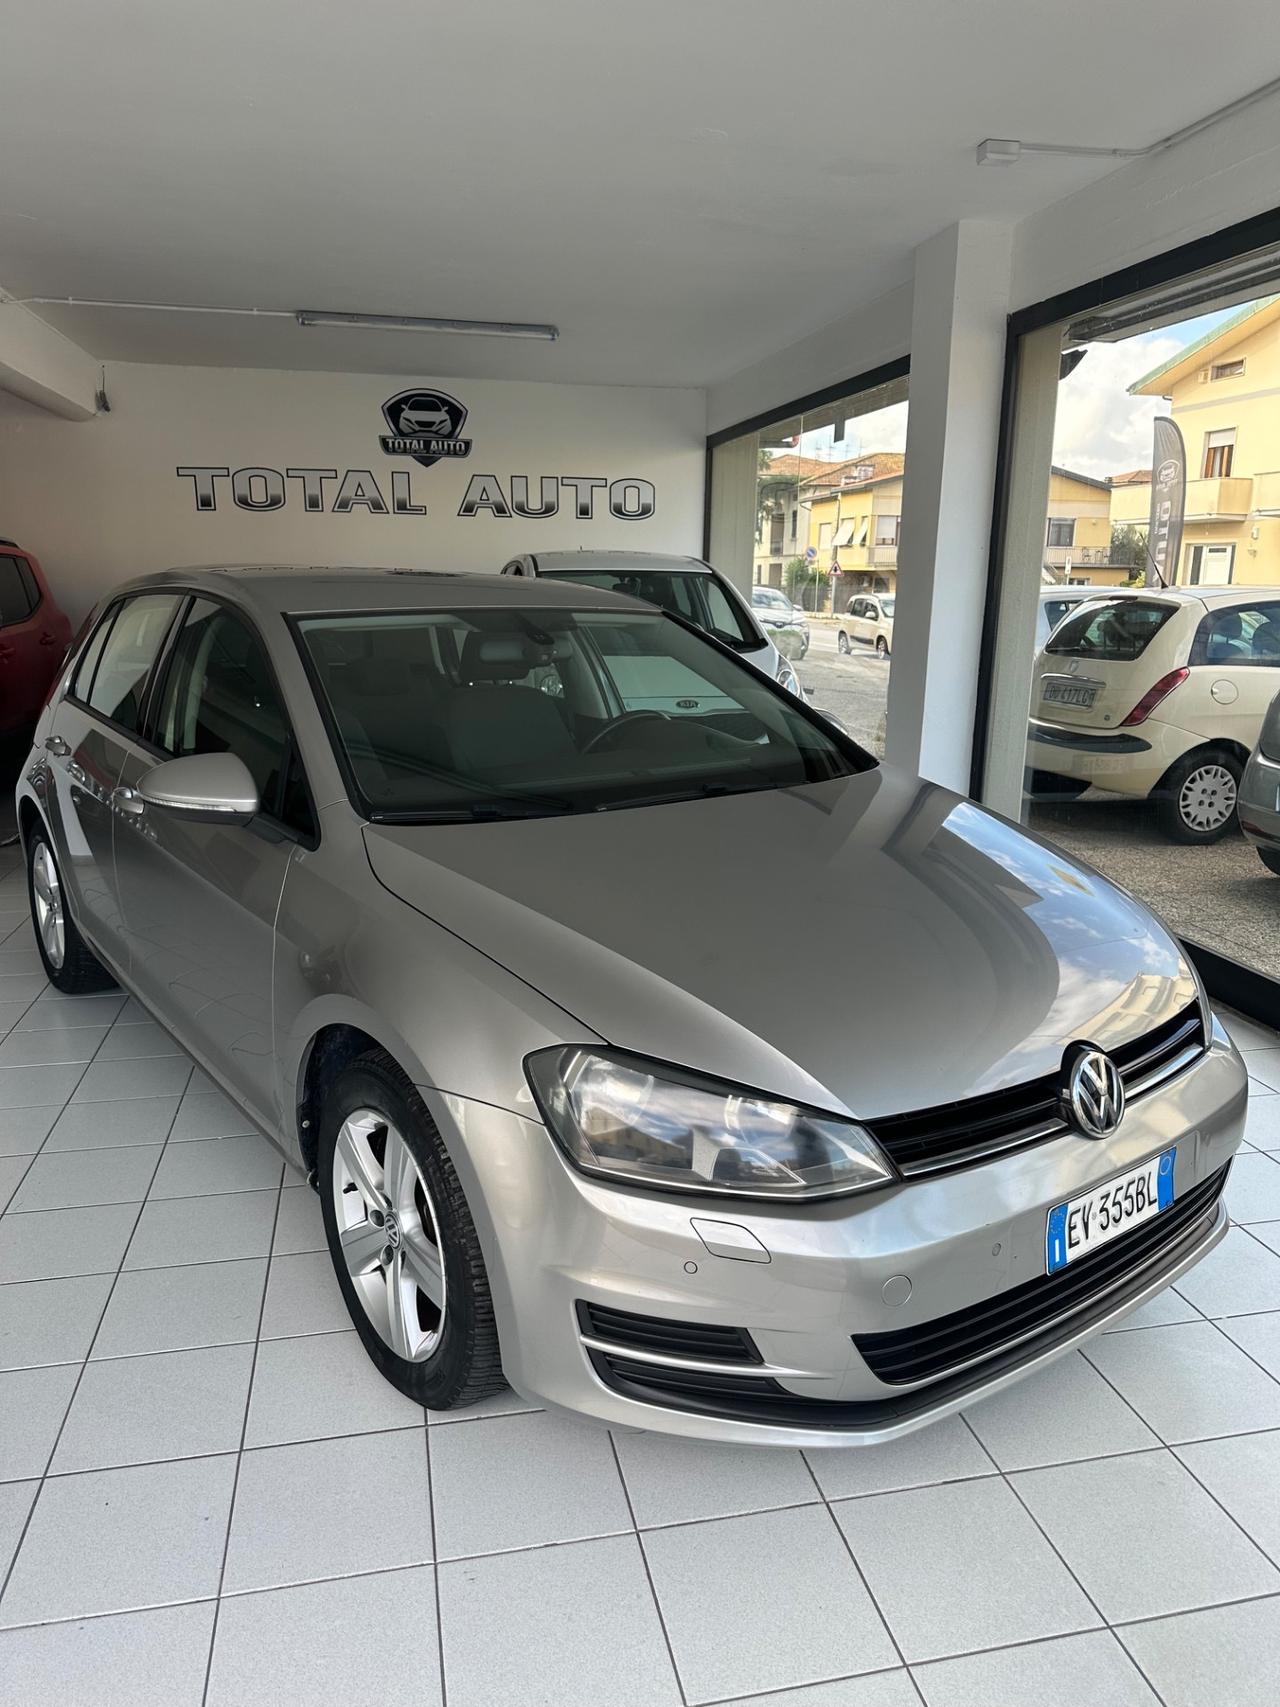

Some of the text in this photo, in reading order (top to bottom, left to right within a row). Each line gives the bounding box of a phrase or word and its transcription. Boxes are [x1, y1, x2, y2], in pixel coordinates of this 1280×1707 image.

[385, 438, 466, 455] TOTAL AUTO
[176, 466, 656, 521] TOTAL AUTO
[1068, 1202, 1093, 1249] EV
[1100, 1171, 1158, 1231] 355BL
